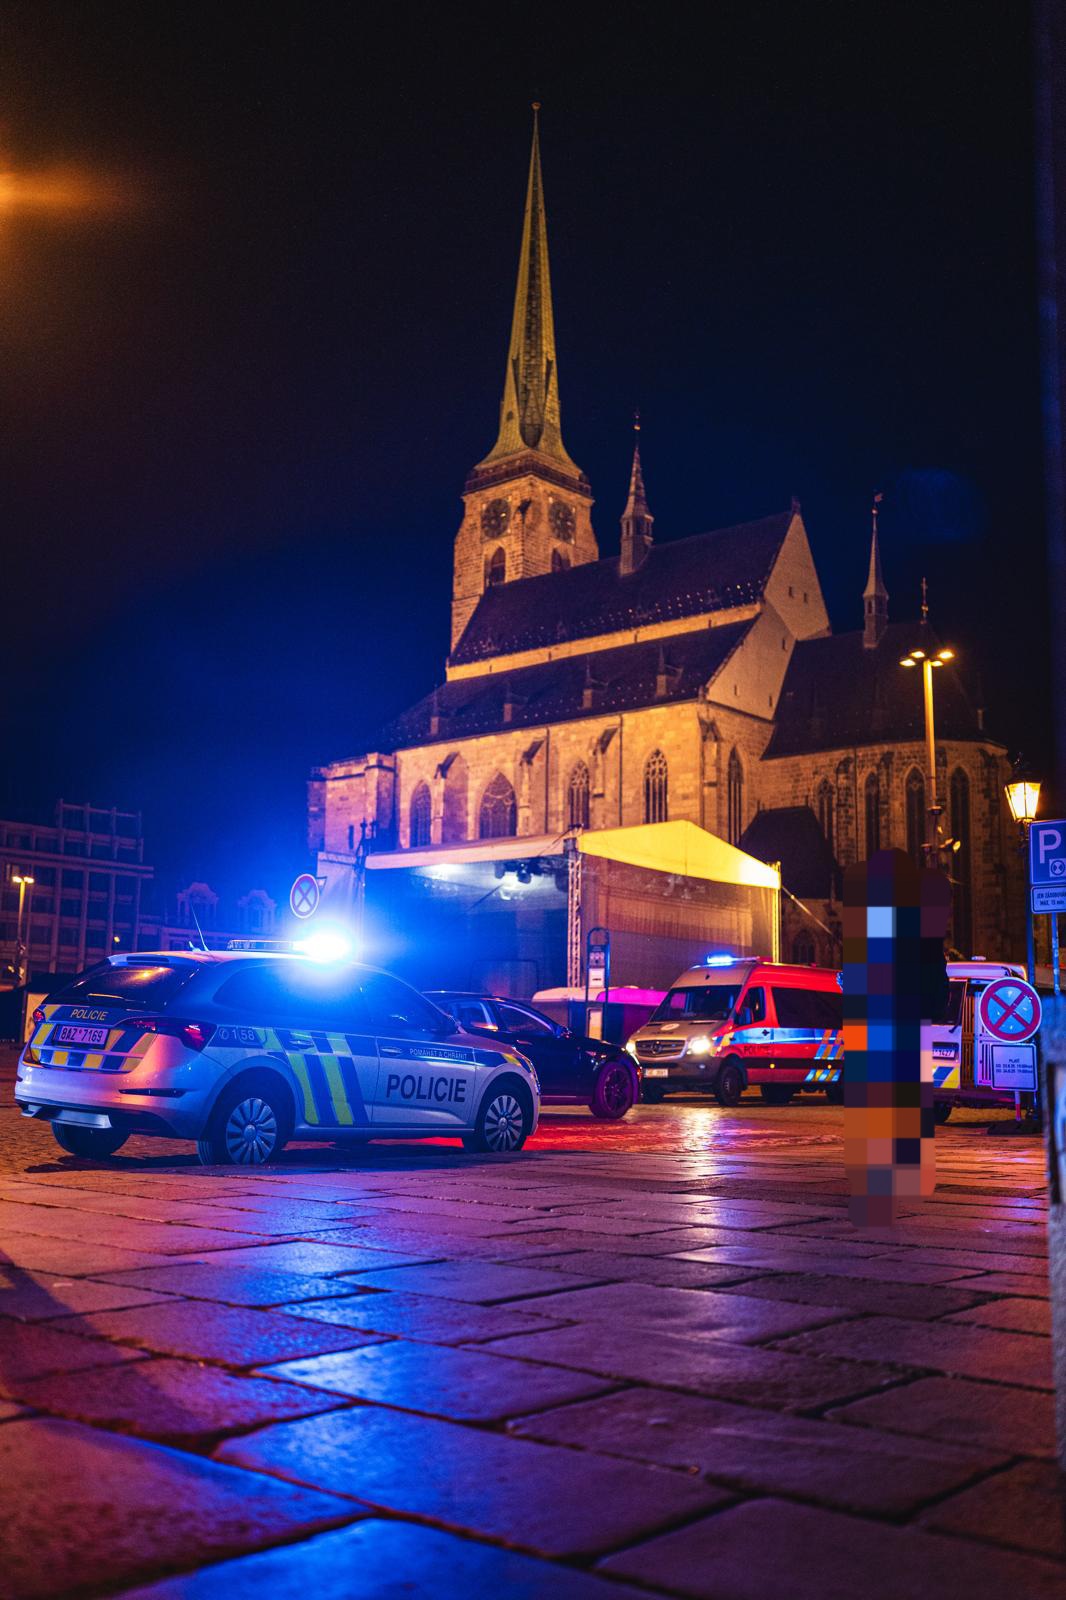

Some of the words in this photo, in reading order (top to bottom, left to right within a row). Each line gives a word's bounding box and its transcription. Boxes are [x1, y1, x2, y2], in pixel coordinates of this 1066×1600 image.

[1039, 829, 1061, 864] P
[70, 1008, 109, 1021] POLICIE
[386, 1074, 466, 1102] POLICIE
